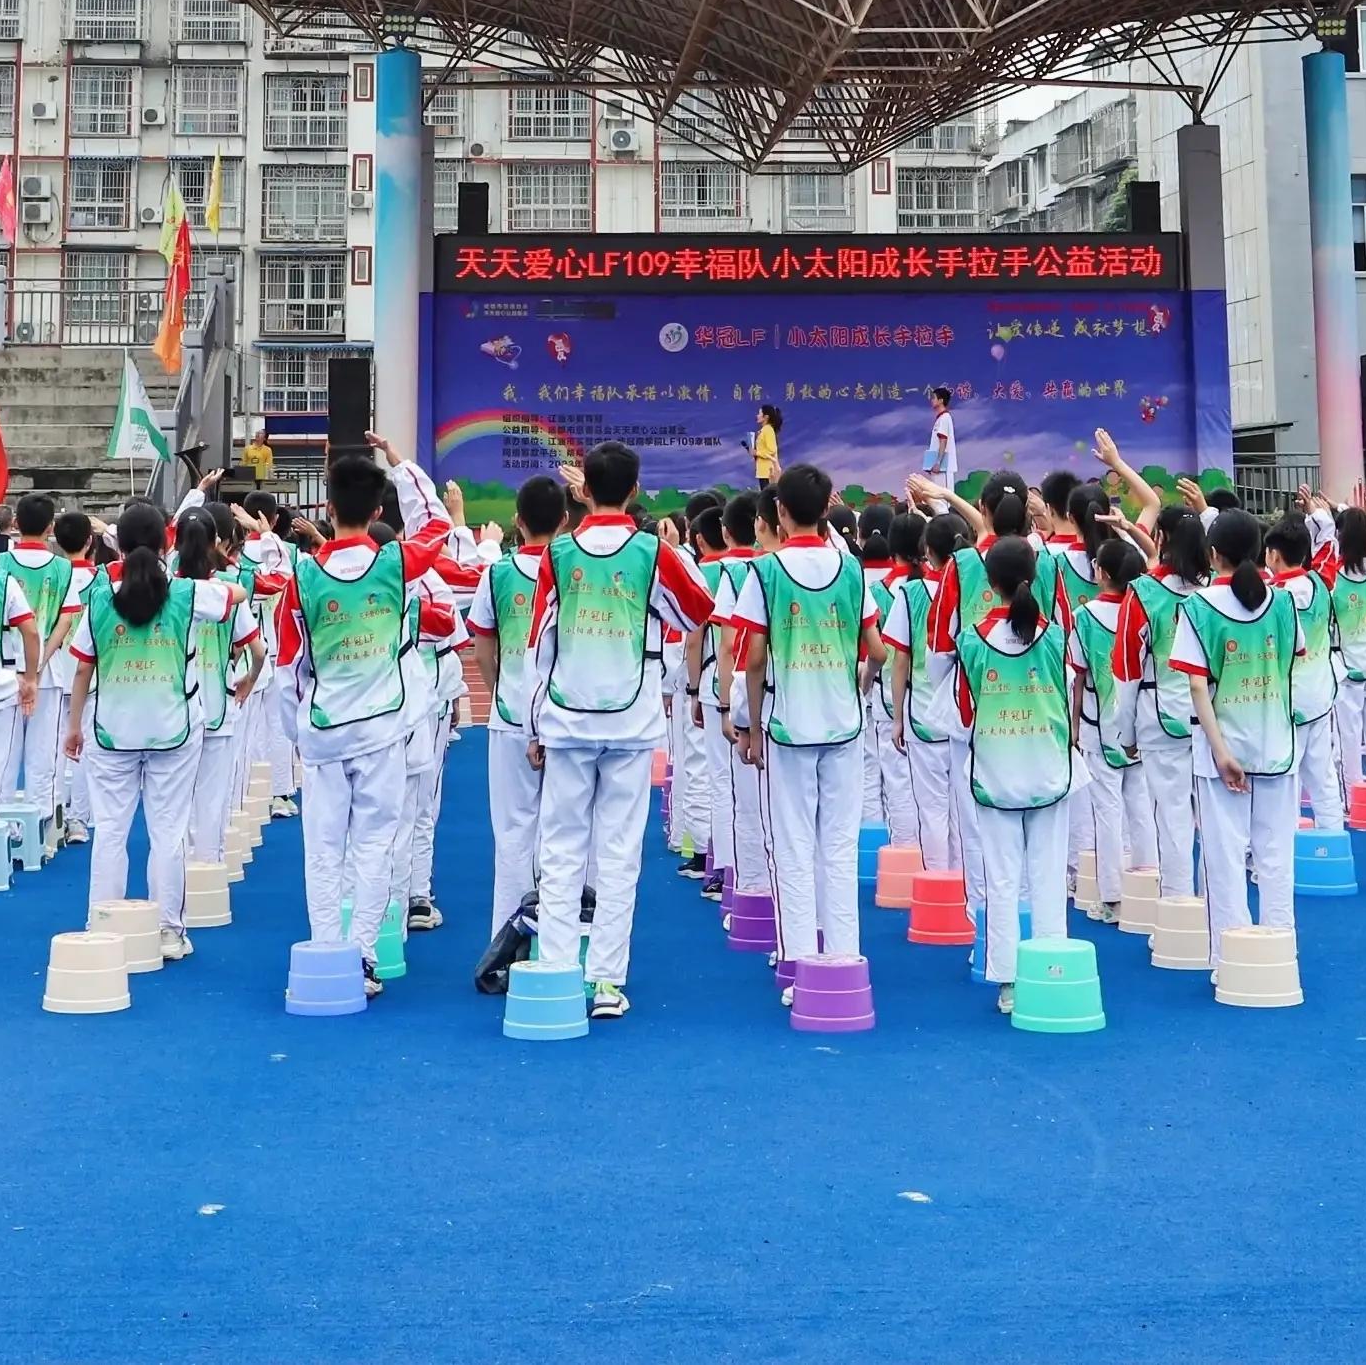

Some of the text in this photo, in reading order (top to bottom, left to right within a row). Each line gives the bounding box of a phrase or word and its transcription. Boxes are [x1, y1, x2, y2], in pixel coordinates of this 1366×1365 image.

[457, 246, 1162, 281] 天天爱心LF109幸福队小太阳成长手拉手公益活动
[694, 325, 954, 348] 华冠LF 小太阳成长手拉手
[578, 609, 614, 622] 华冠LF
[800, 643, 831, 655] 华冠LF
[999, 709, 1033, 721] 华冠LF
